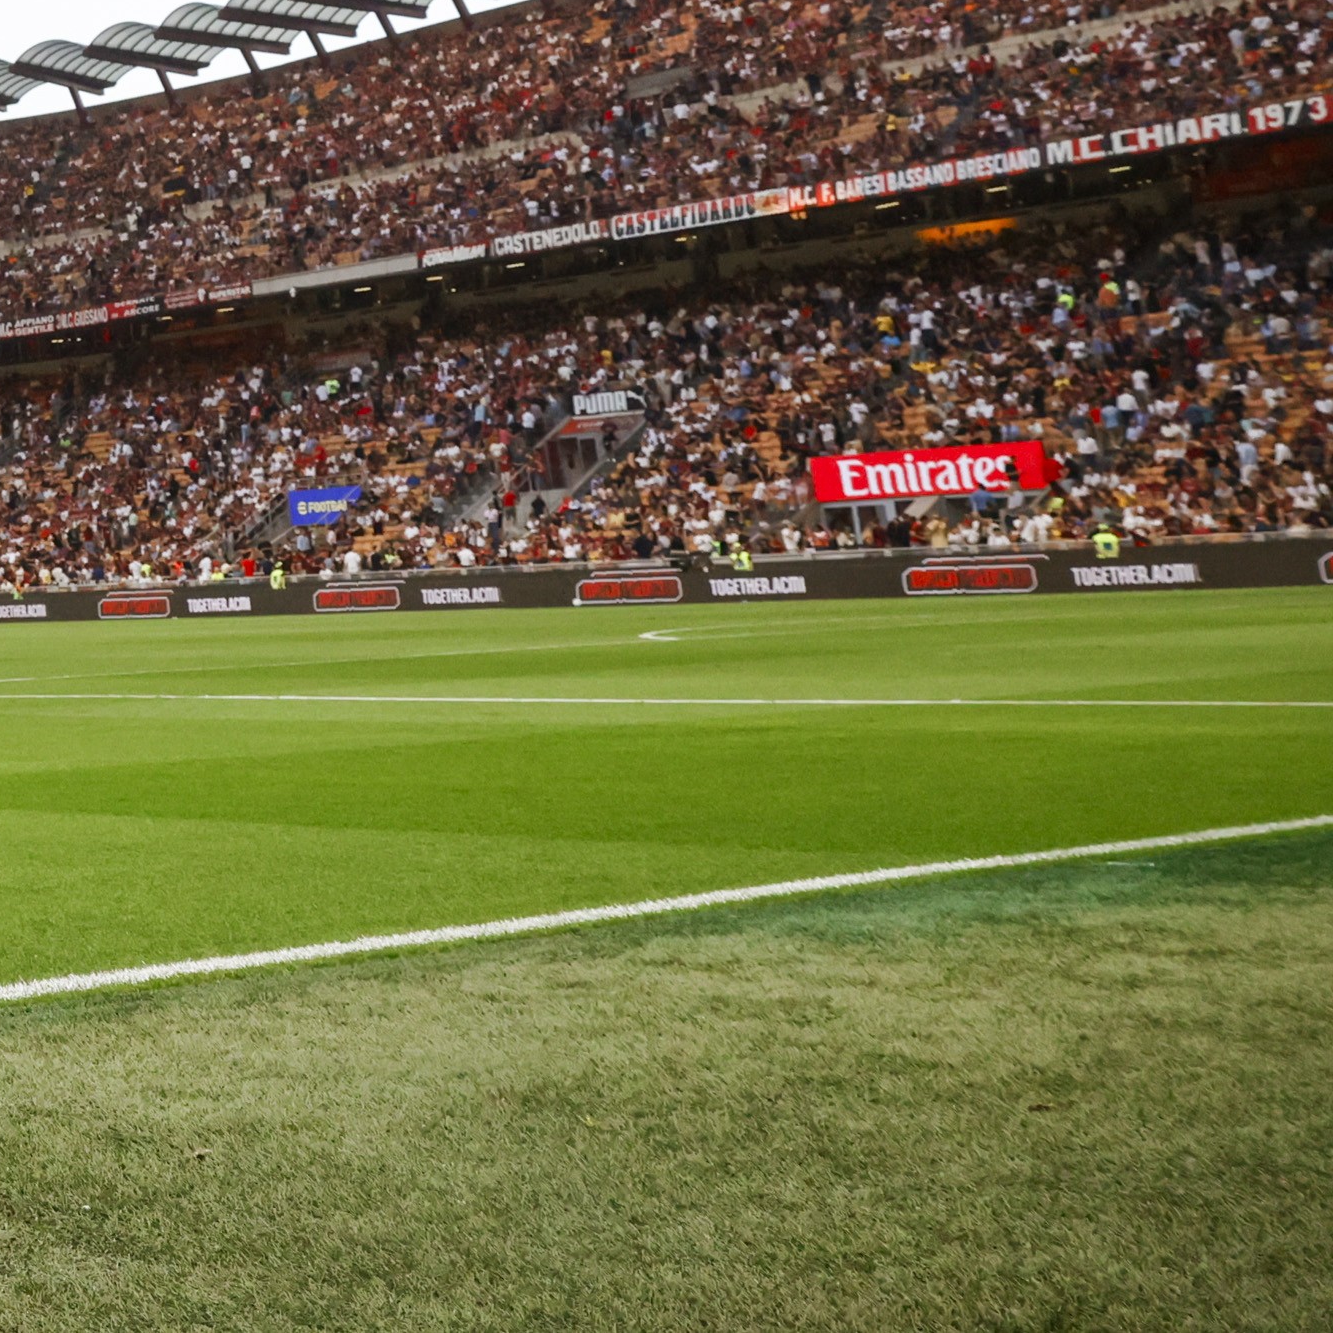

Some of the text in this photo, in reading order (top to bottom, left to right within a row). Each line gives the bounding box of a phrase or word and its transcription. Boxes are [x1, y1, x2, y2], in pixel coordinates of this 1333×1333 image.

[1248, 97, 1327, 131] 1973
[836, 172, 885, 199] BARESI
[887, 160, 955, 192] BASSANO
[956, 149, 1040, 180] BRESCIANO
[573, 391, 628, 415] PUMA
[837, 453, 1013, 497] Emirates
